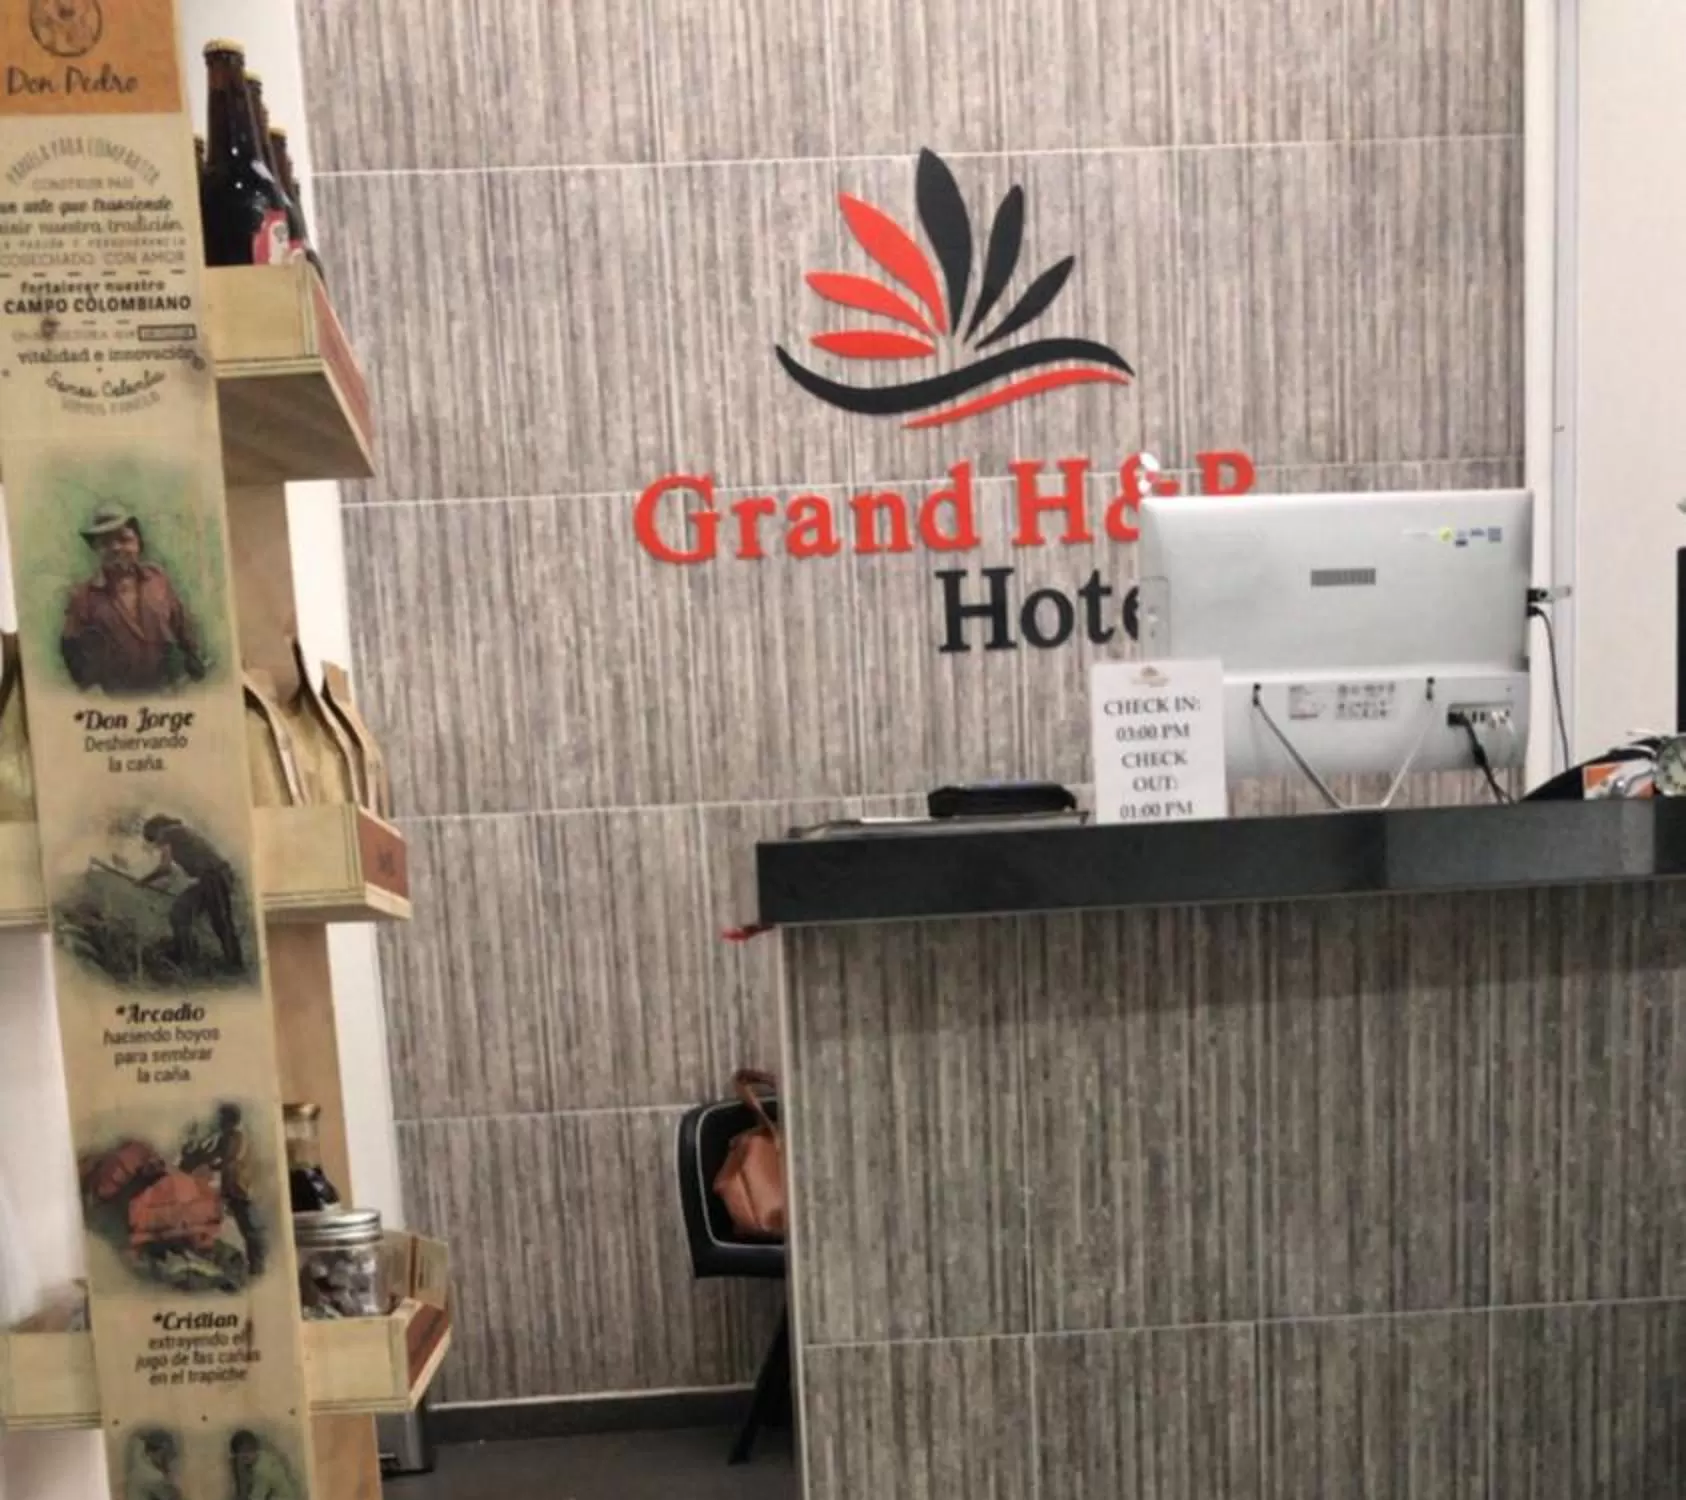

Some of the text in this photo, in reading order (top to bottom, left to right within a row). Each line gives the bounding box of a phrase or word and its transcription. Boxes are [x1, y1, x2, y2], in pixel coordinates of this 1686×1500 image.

[8, 63, 139, 96] Don Pedro
[4, 295, 192, 315] CAMPO COLOMBIANO
[634, 460, 980, 565] Grand
[1103, 698, 1169, 716] CHECK
[136, 705, 195, 733] Jorge
[1115, 722, 1190, 742] 03:00 PM
[108, 755, 122, 772] la
[1120, 750, 1187, 769] CHECK
[1119, 801, 1193, 820] 01:00 PM
[103, 1026, 220, 1046] haciendo hoyos
[115, 1046, 213, 1068] para sembrar
[136, 1067, 150, 1083] la
[148, 1331, 229, 1350] extrayendo
[135, 1354, 169, 1372] jugo
[171, 1352, 190, 1366] de
[193, 1350, 214, 1365] las
[149, 1372, 168, 1386] en
[171, 1370, 184, 1384] el
